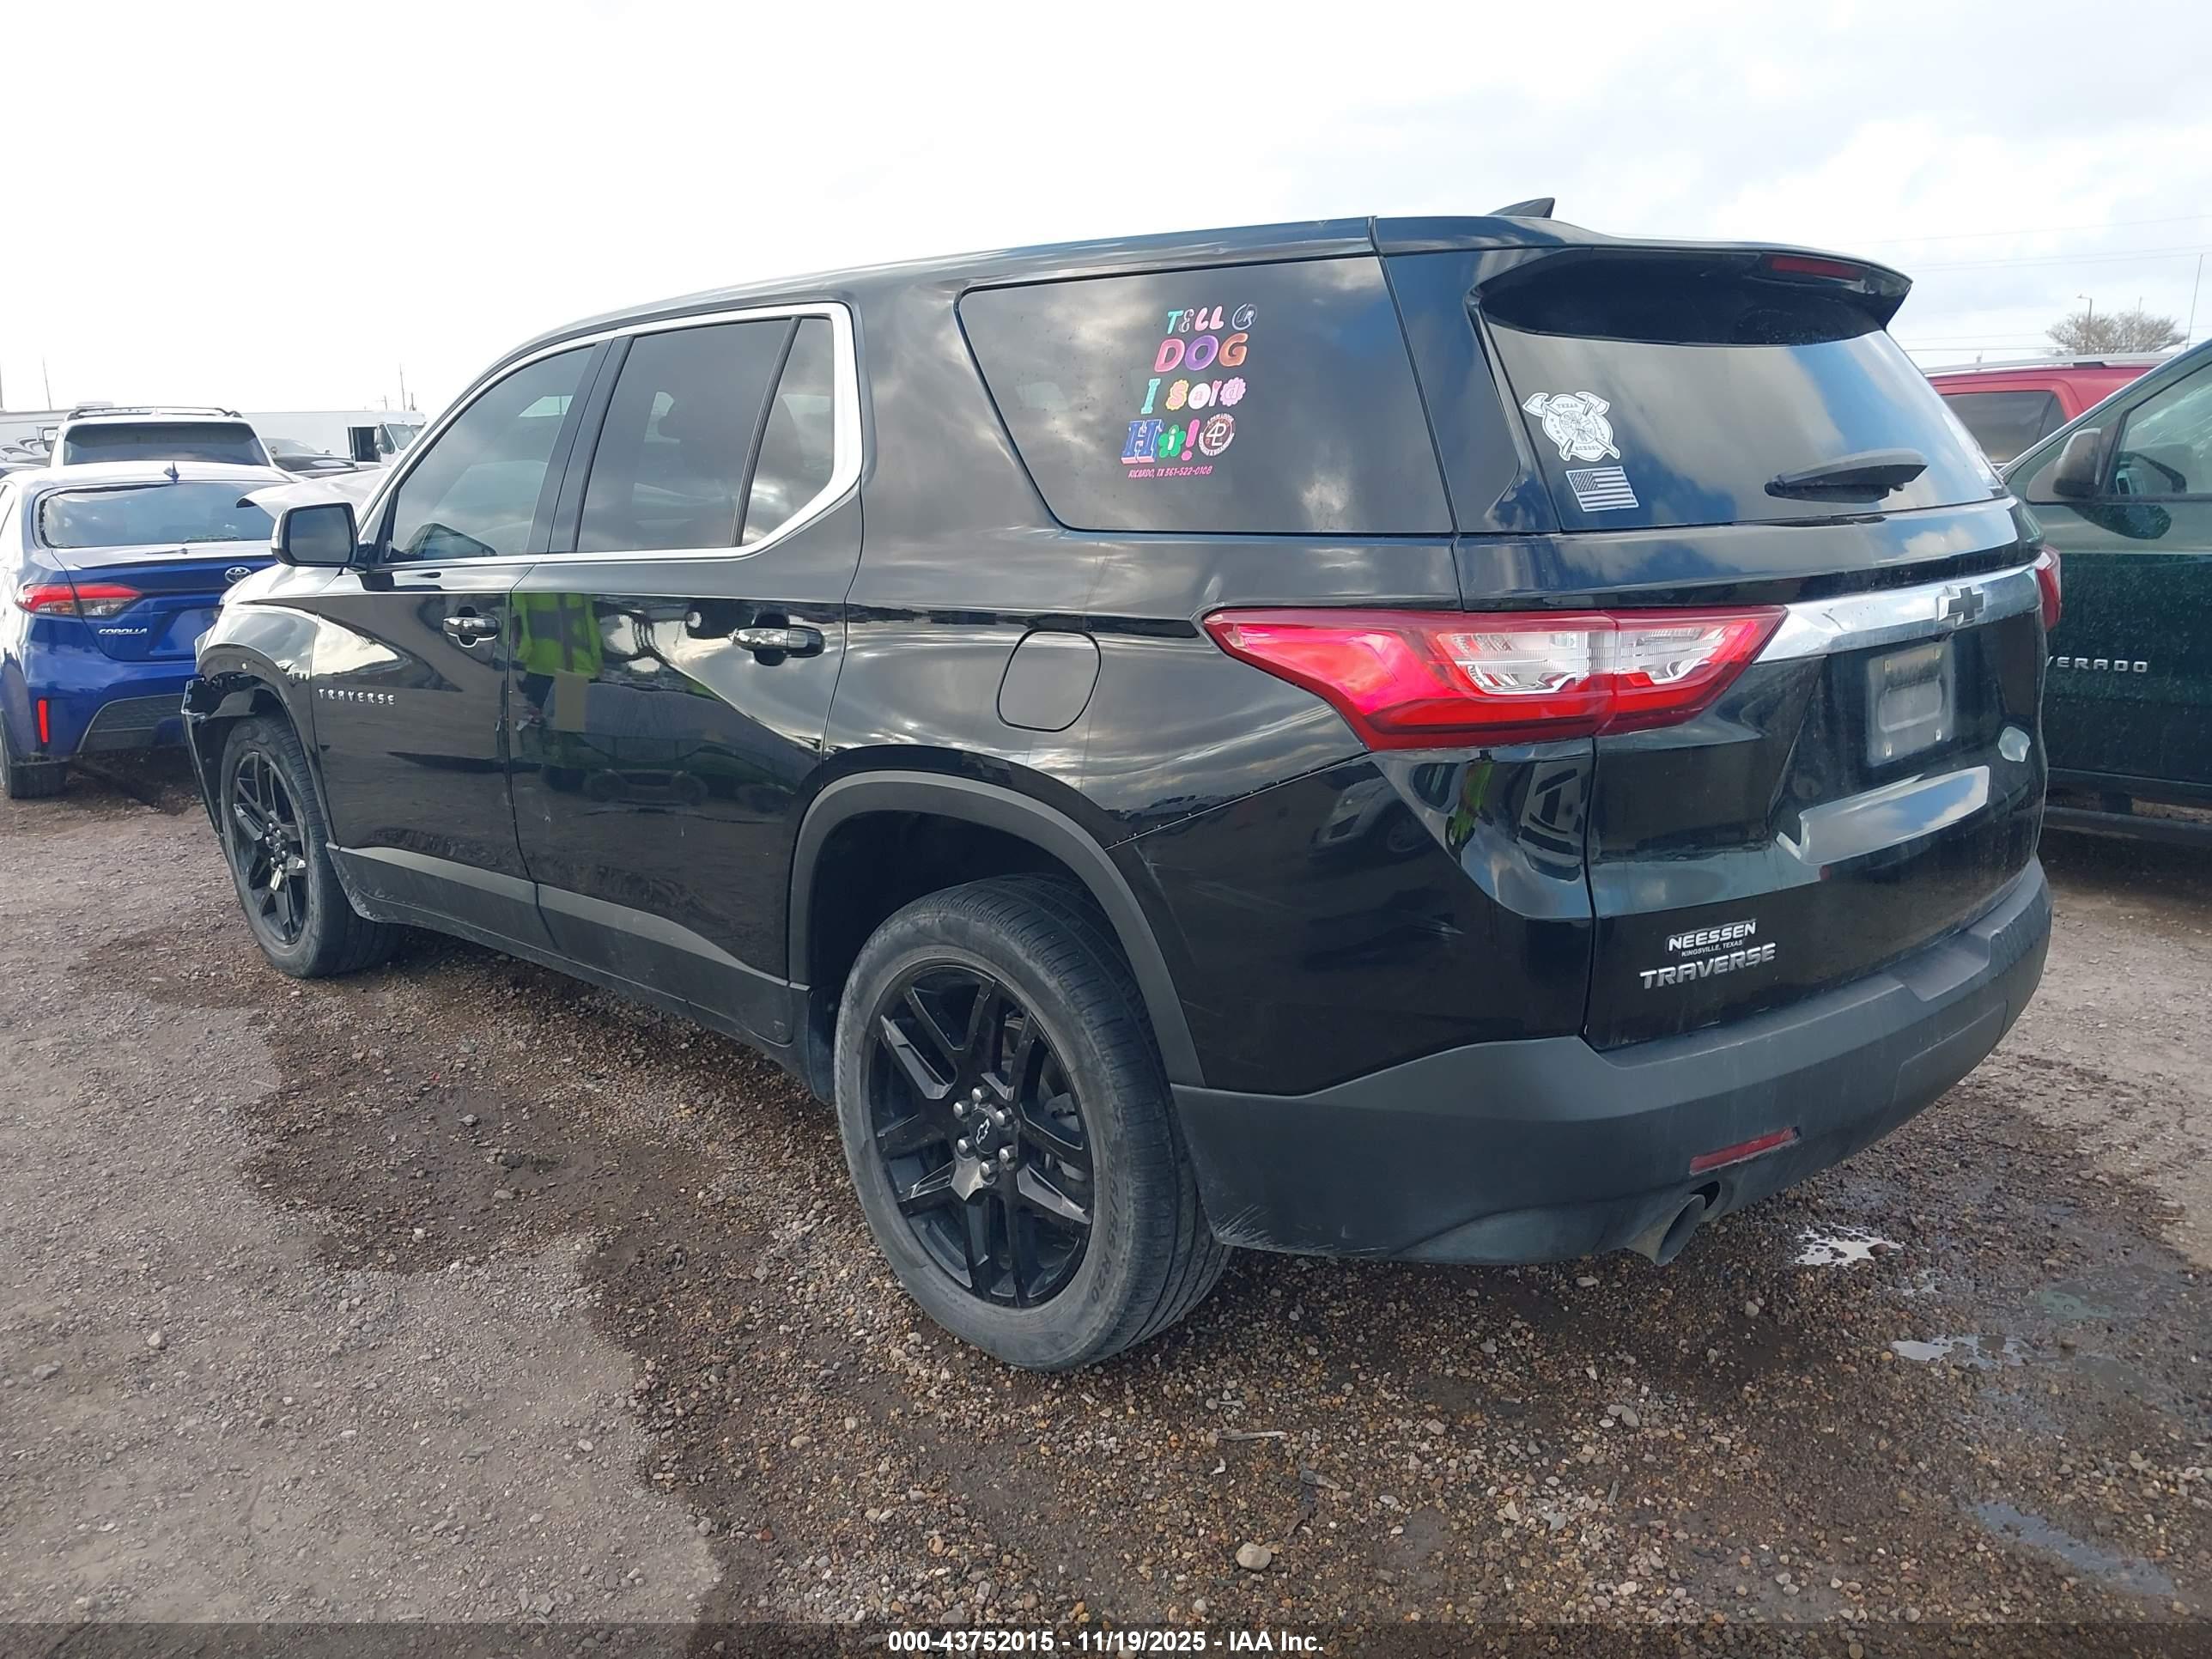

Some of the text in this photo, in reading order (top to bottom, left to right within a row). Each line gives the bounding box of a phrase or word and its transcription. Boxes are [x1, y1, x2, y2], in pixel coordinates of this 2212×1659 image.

[1154, 333, 1249, 372] DOG
[1140, 378, 1161, 414] I
[319, 689, 395, 705] TRAVERSE
[1668, 921, 1756, 951] NEESSEN
[1723, 939, 1743, 950] TEXAS
[1639, 942, 1777, 989] TRAVERSE
